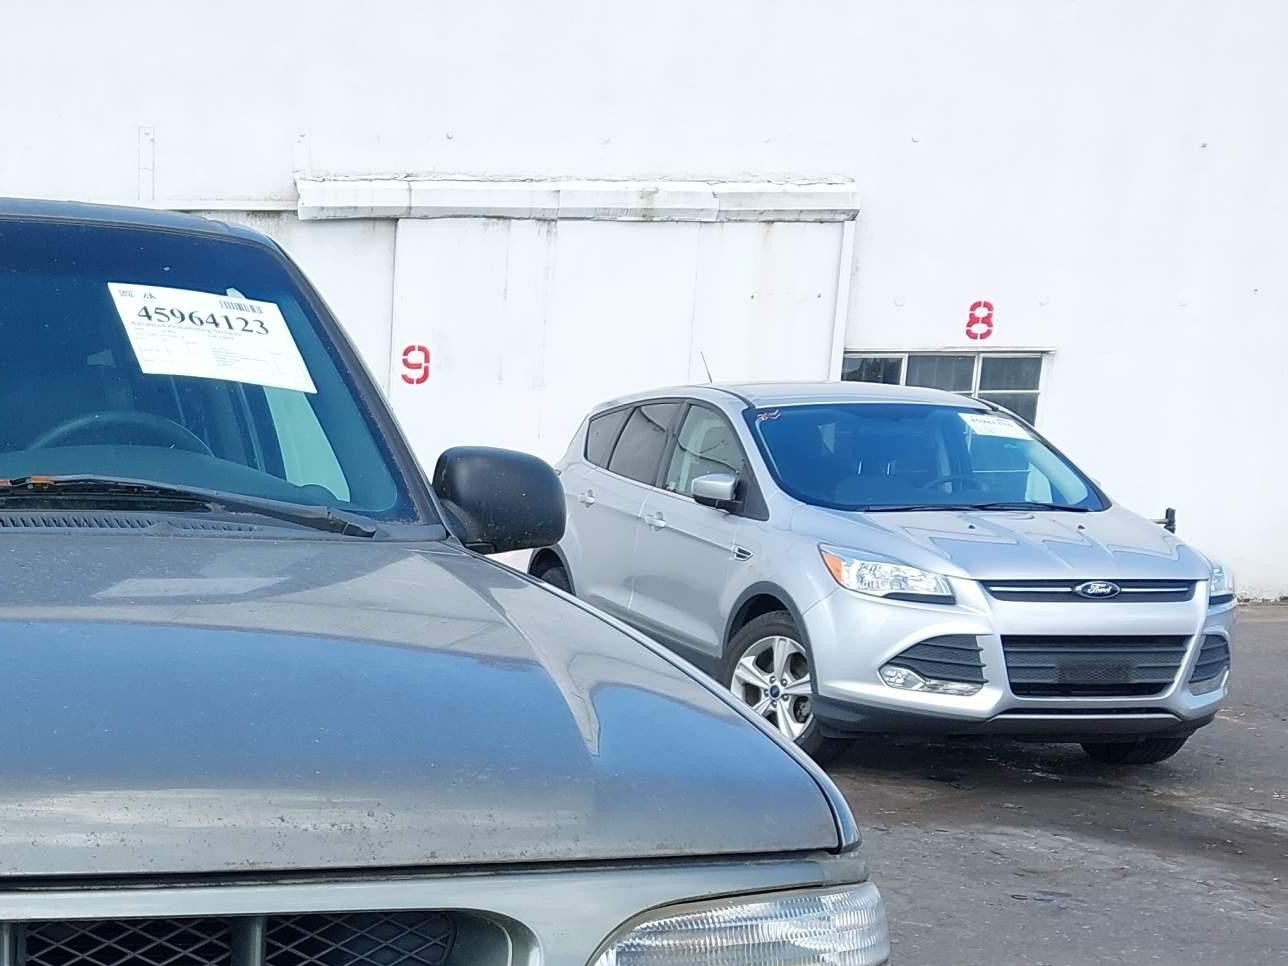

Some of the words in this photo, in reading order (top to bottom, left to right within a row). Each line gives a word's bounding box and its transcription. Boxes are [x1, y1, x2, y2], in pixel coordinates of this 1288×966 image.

[137, 305, 270, 336] 45964123
[966, 300, 994, 340] 8
[401, 344, 431, 385] 9
